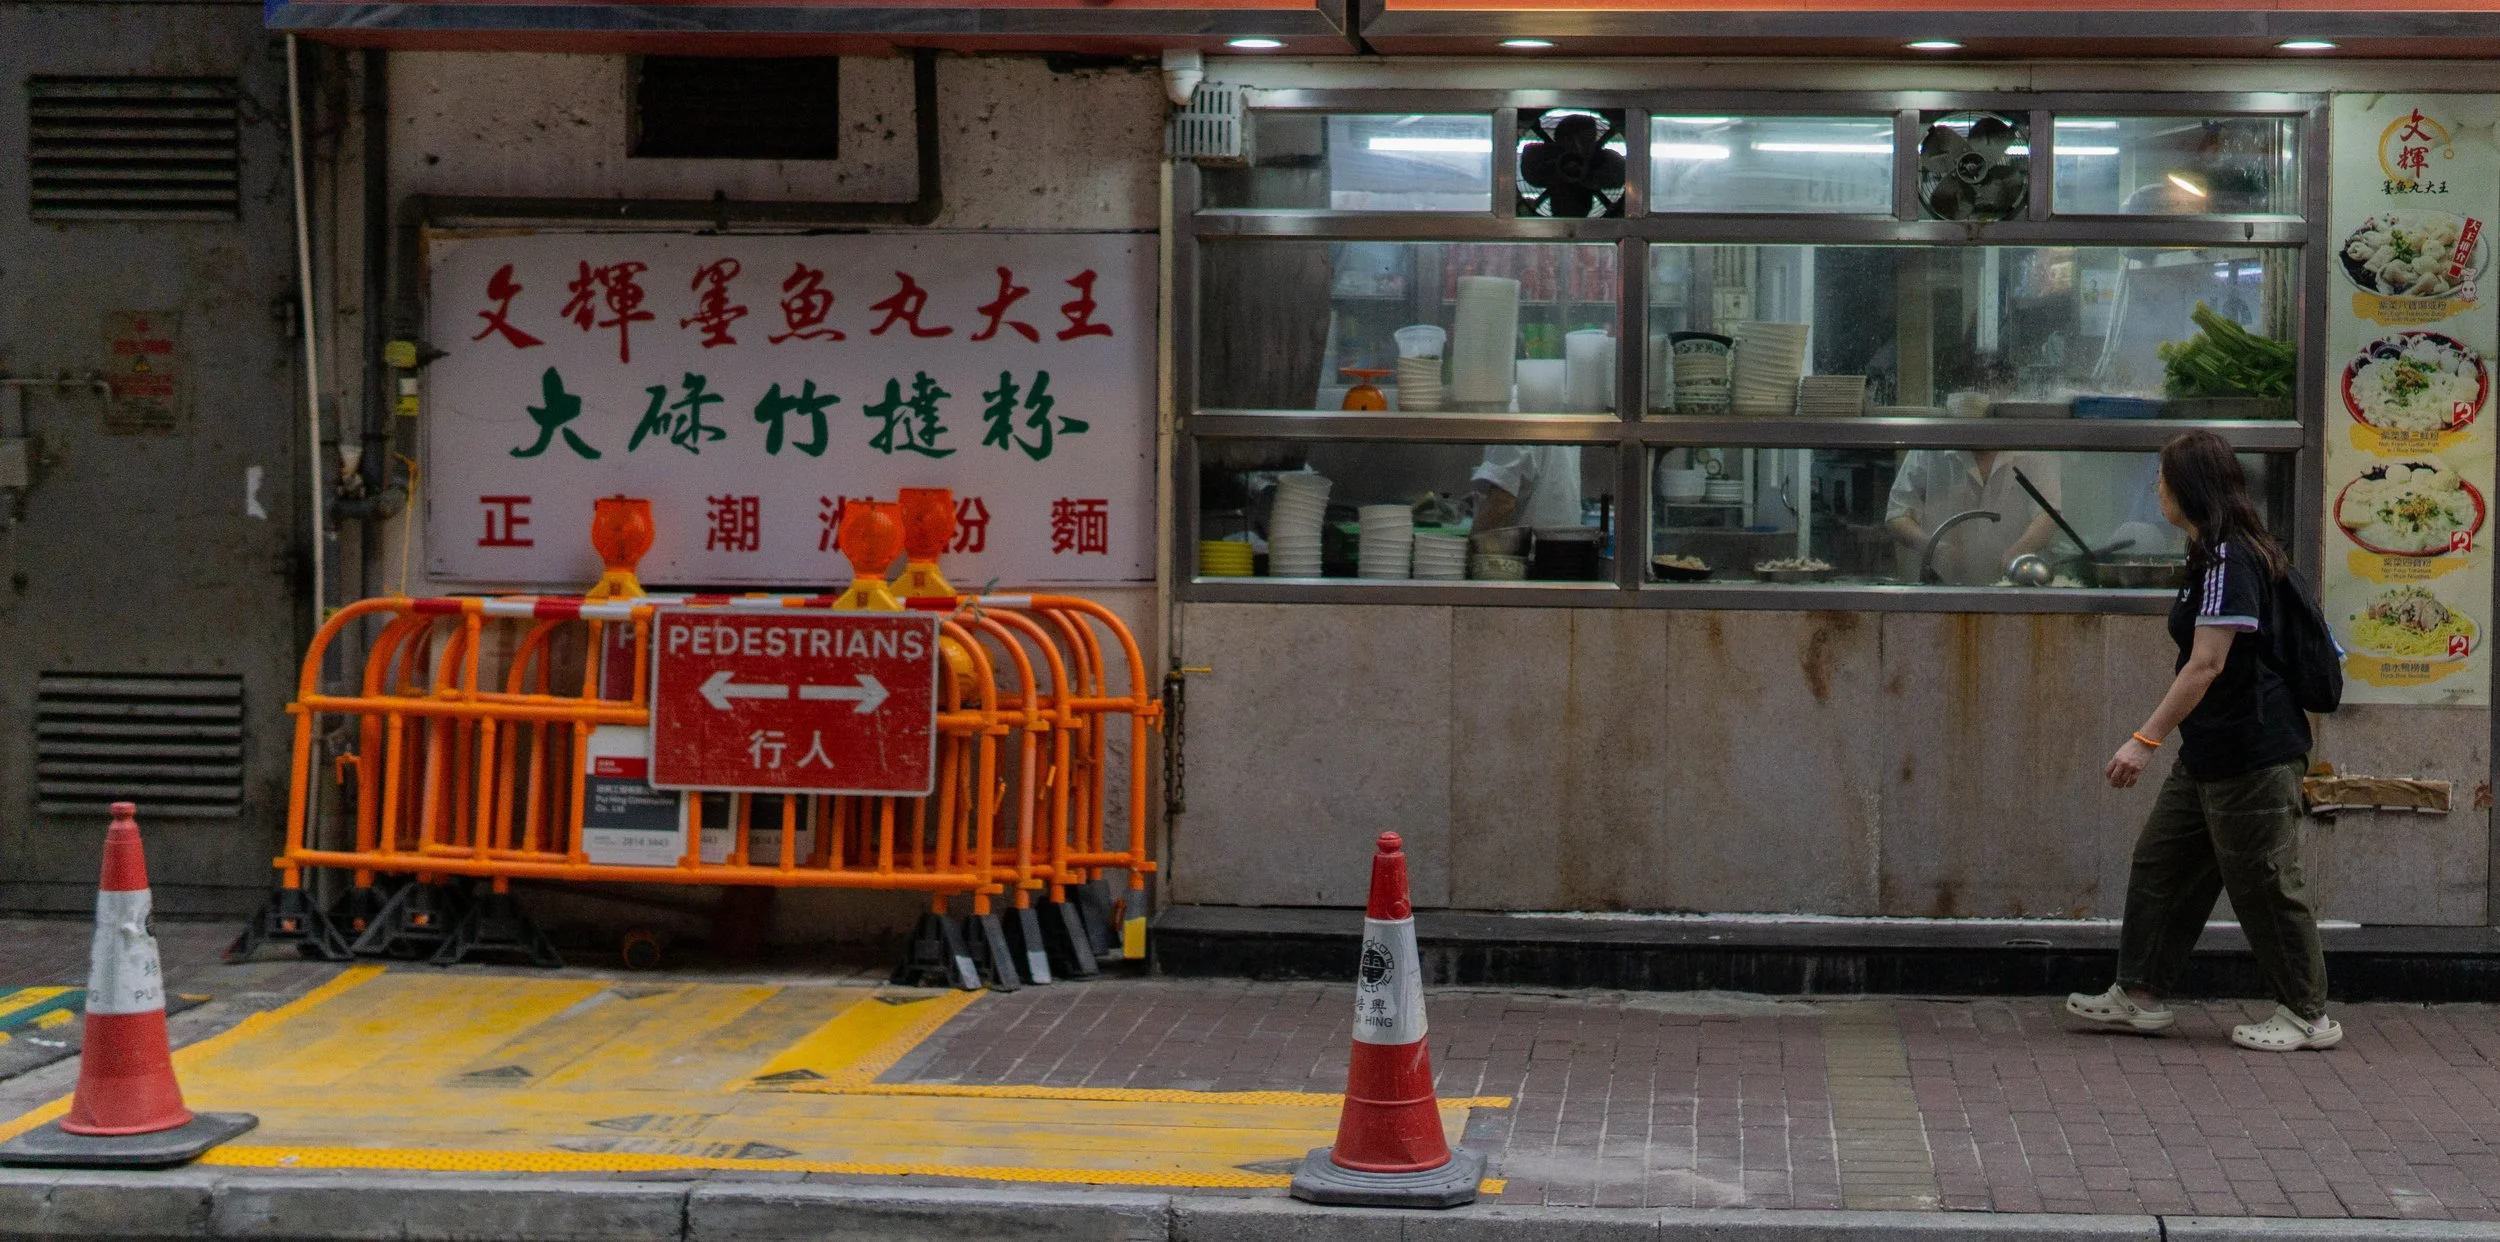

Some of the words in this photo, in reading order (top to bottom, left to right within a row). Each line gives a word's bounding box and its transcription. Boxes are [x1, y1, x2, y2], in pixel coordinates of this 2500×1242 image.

[2396, 107, 2433, 179] 文輝
[472, 257, 1114, 364] 文輝墨魚丸大王
[669, 625, 925, 661] PEDESTRIANS
[749, 730, 834, 769] 行人
[1365, 1015, 1394, 1028] HING
